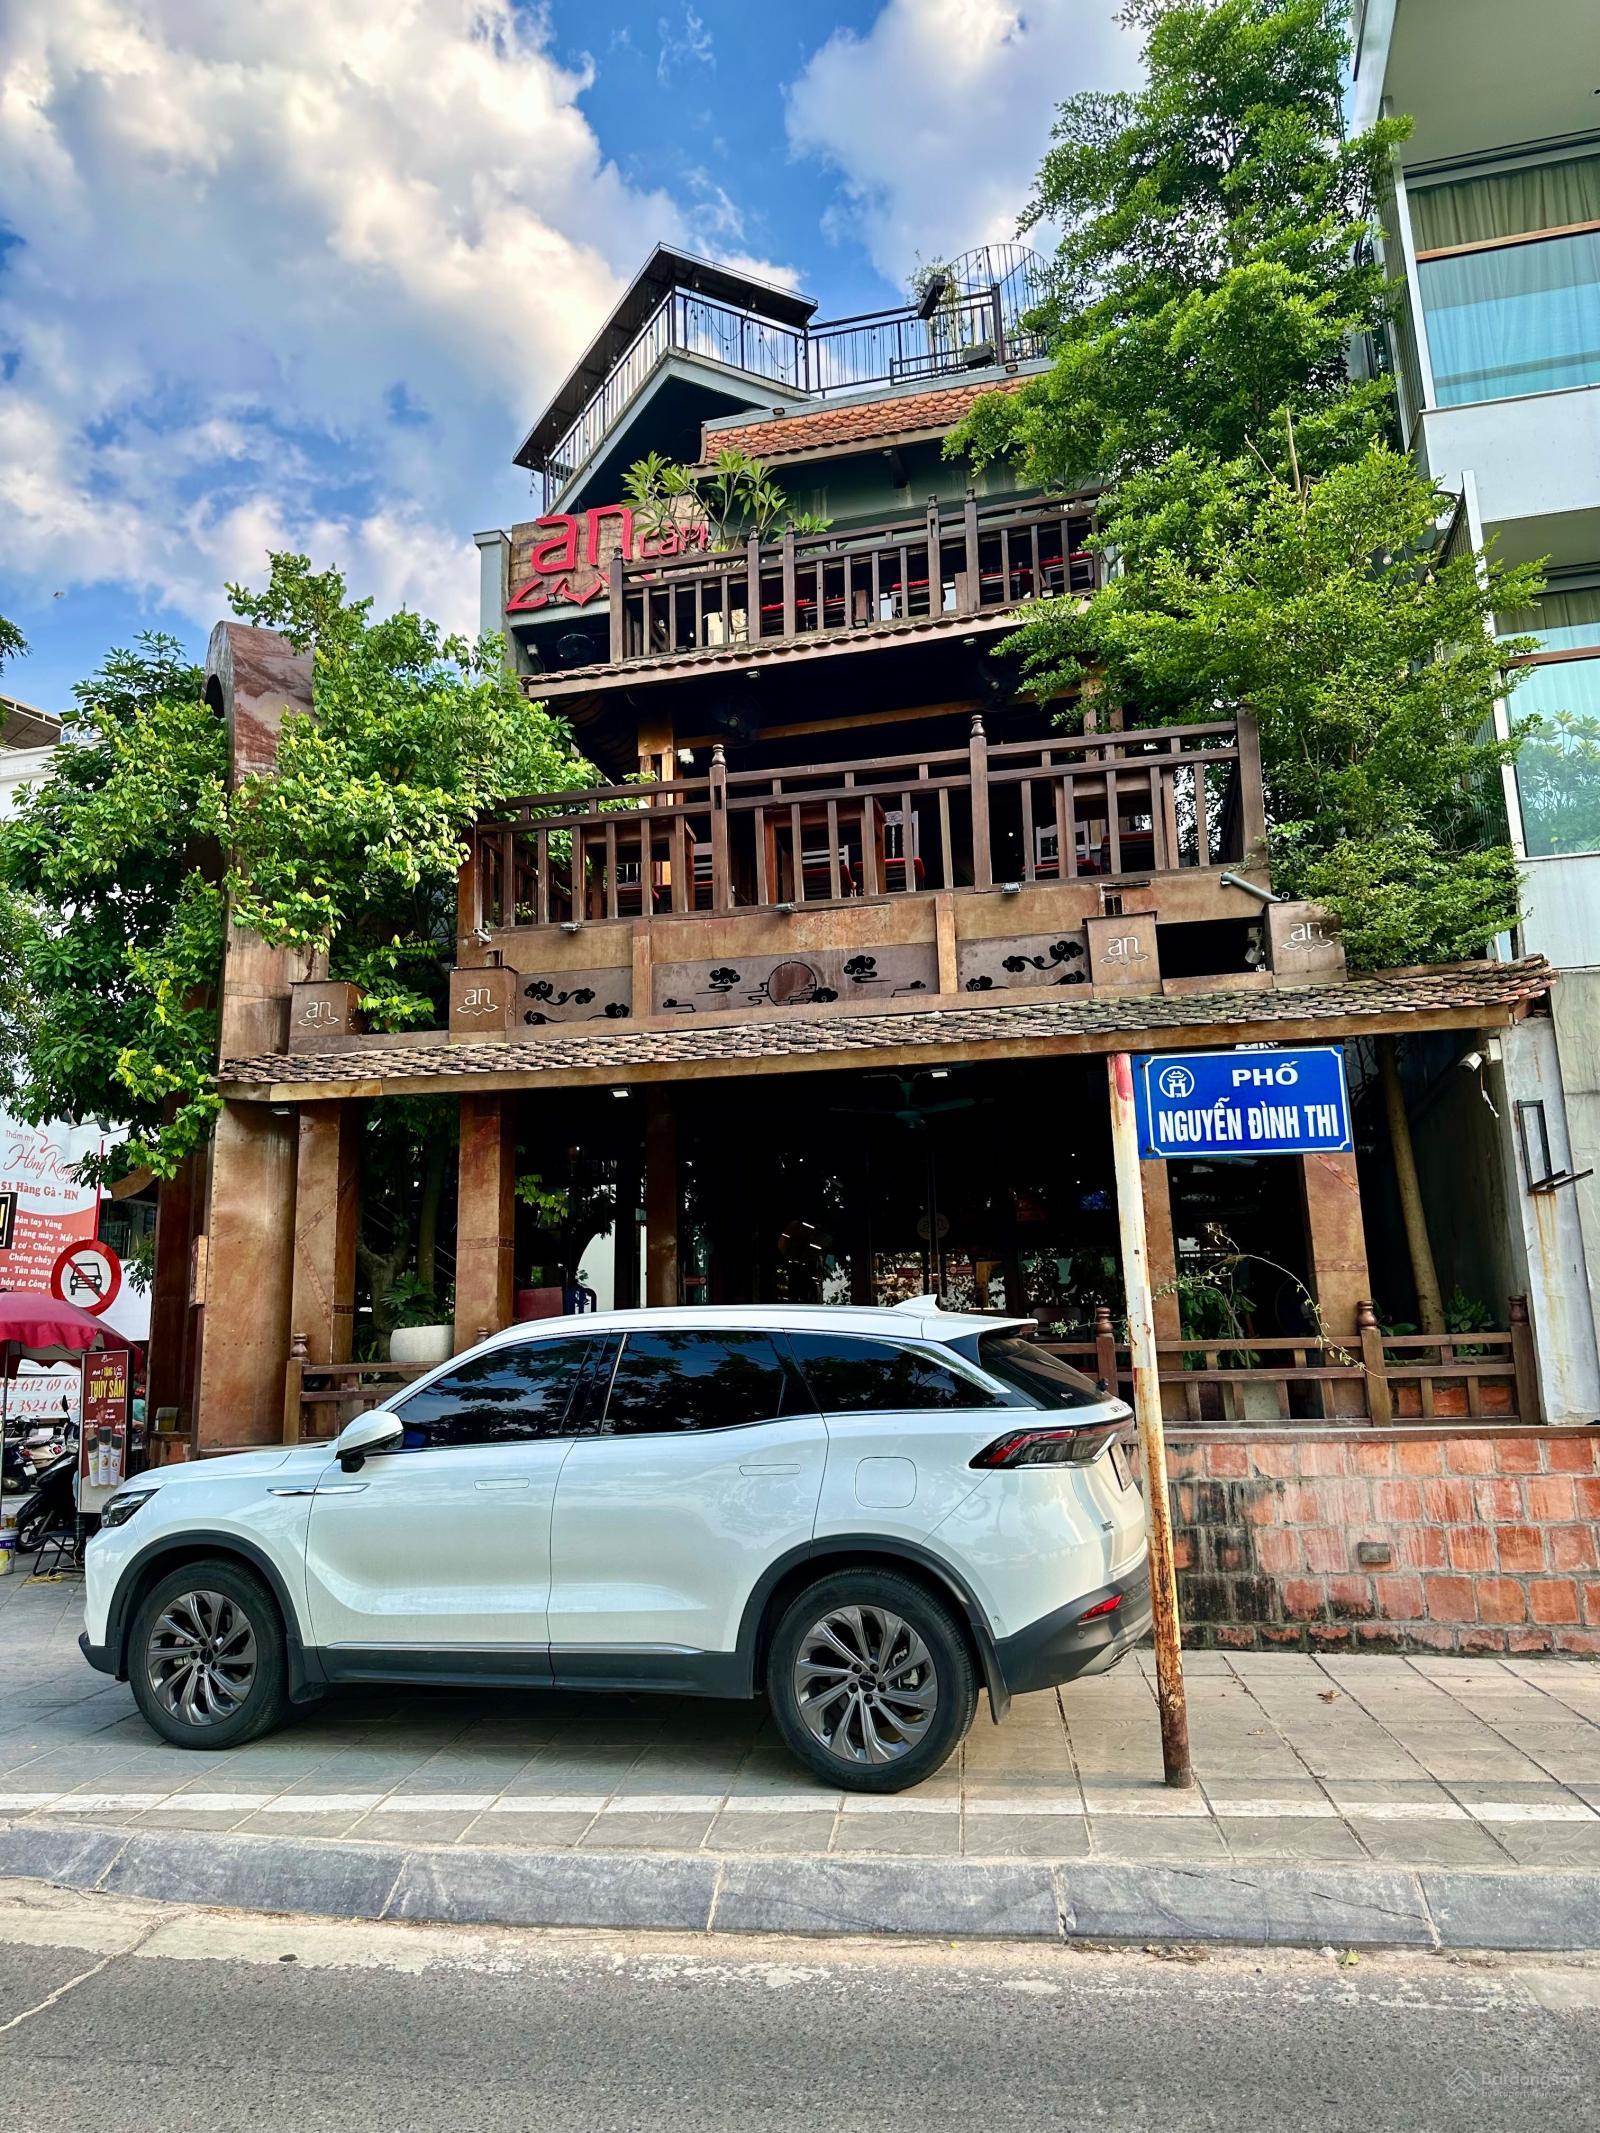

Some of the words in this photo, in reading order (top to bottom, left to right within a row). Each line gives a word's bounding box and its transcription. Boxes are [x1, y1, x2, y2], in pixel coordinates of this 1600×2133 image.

[531, 504, 633, 574] an
[1290, 922, 1323, 942] an
[1108, 936, 1139, 957] an
[464, 988, 491, 1006] an
[305, 1001, 332, 1019] an
[1231, 1061, 1299, 1087] PHỐ
[1158, 1097, 1243, 1143] NGUYỄN
[1247, 1101, 1300, 1140] ĐÌNH
[1304, 1104, 1340, 1138] THI
[16, 1182, 41, 1197] Hàng
[64, 1190, 79, 1201] HN
[30, 1217, 43, 1227] tay
[33, 1241, 55, 1253] Chống
[9, 1252, 33, 1264] Chống
[21, 1378, 44, 1392] 612
[46, 1378, 61, 1392] 69
[64, 1378, 79, 1392] 68
[17, 1399, 47, 1413] 3824
